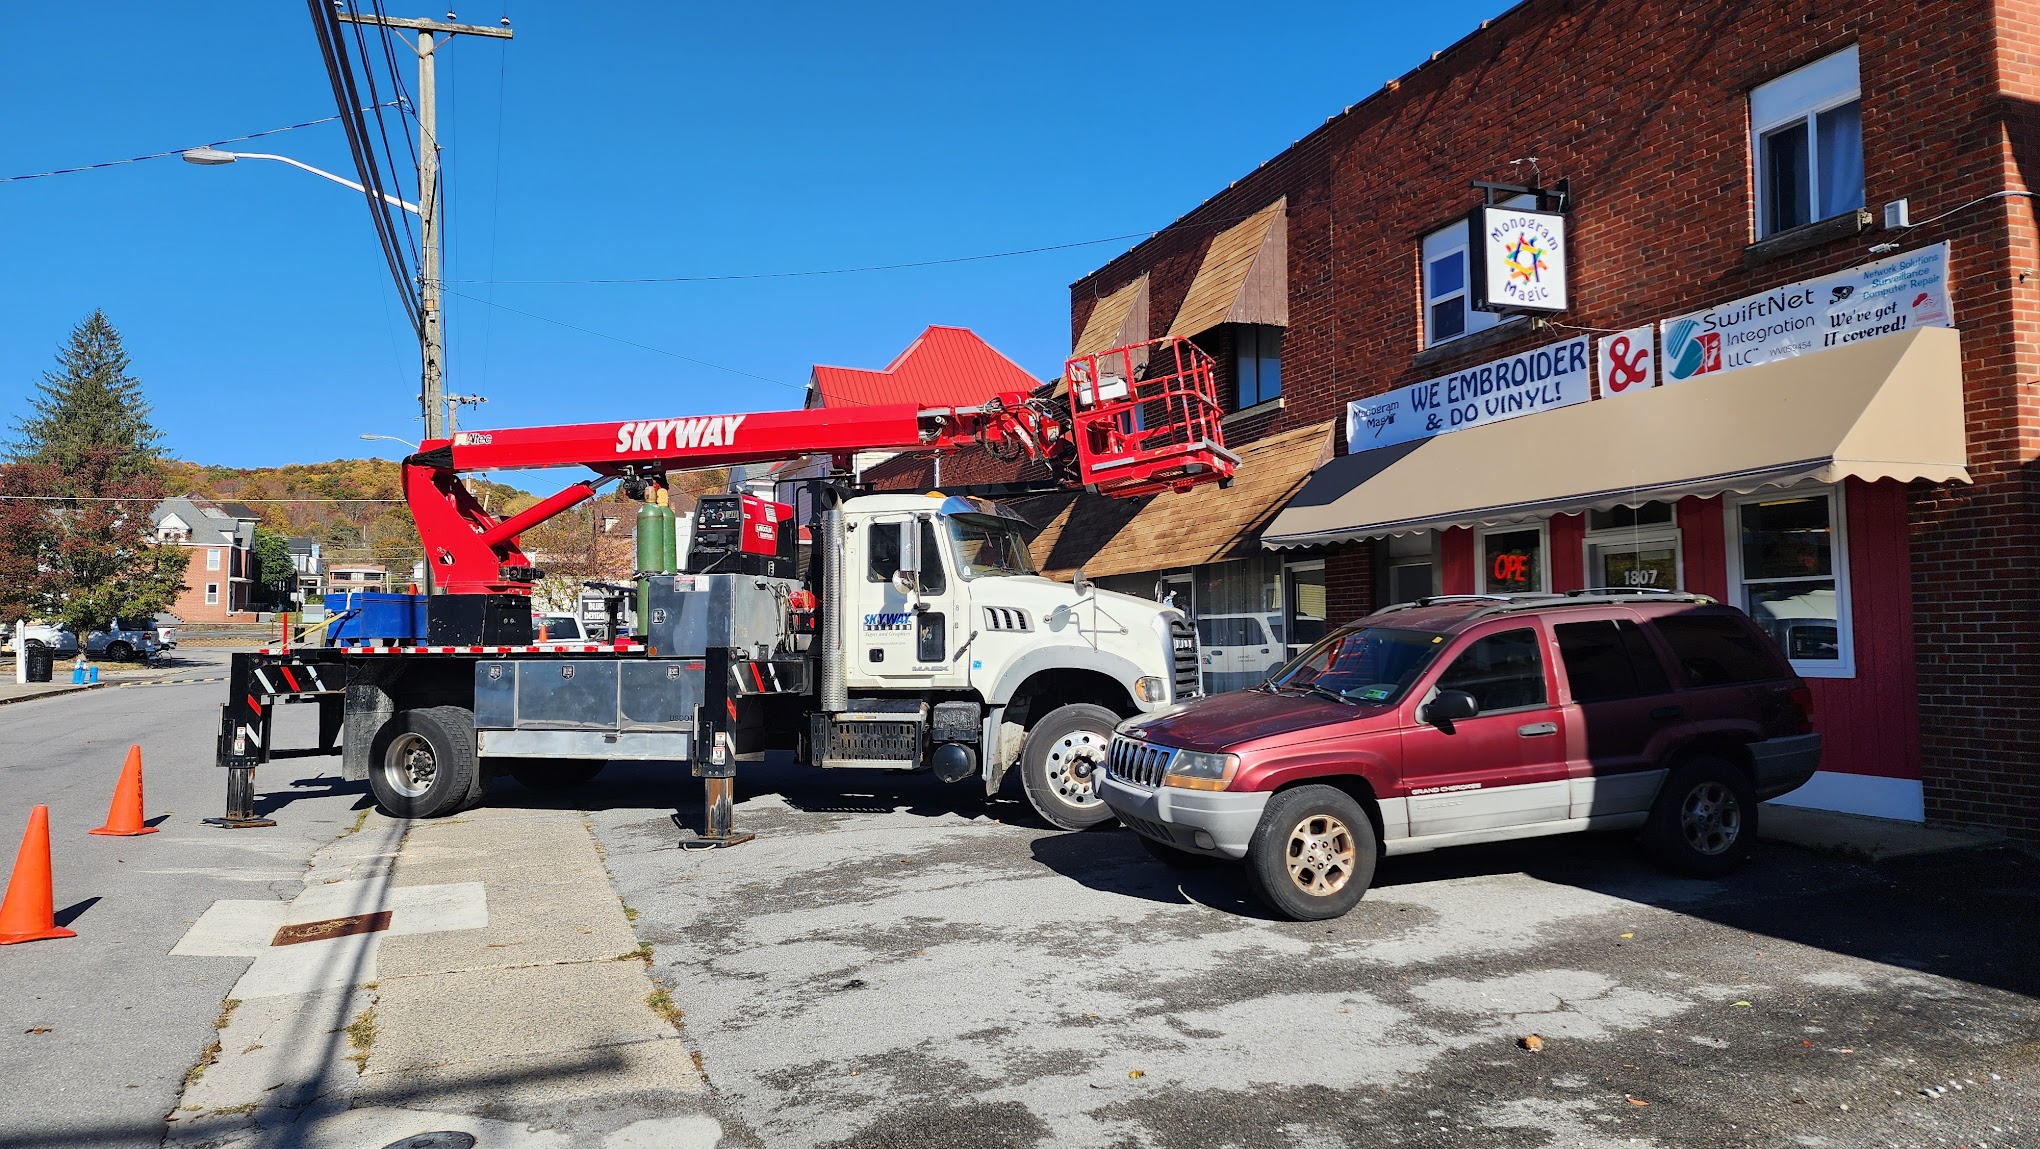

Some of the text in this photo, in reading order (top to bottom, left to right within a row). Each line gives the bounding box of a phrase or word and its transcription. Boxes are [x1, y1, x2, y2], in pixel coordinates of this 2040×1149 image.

[1490, 217, 1559, 251] Monogram
[1863, 253, 1939, 280] Network Solutions
[1871, 267, 1930, 289] Surveillance
[1504, 280, 1549, 302] Magic
[1862, 274, 1940, 300] Computer Repair
[1703, 288, 1815, 333] SwiftNet
[1830, 301, 1898, 328] We've got
[1727, 316, 1815, 346] Integration
[1824, 314, 1907, 347] IT covered!
[1411, 341, 1587, 413] WE EMBROIDER
[1609, 335, 1649, 393] &
[1353, 401, 1400, 420] Monogram
[1425, 381, 1562, 431] & DO VINYL!
[615, 415, 747, 454] SKYWAY
[1367, 413, 1396, 429] Mag
[467, 432, 493, 446] Altec
[1624, 569, 1658, 585] 1807
[864, 613, 912, 625] SKYWAY
[1411, 782, 1482, 795] GRAND CHEROKEE
